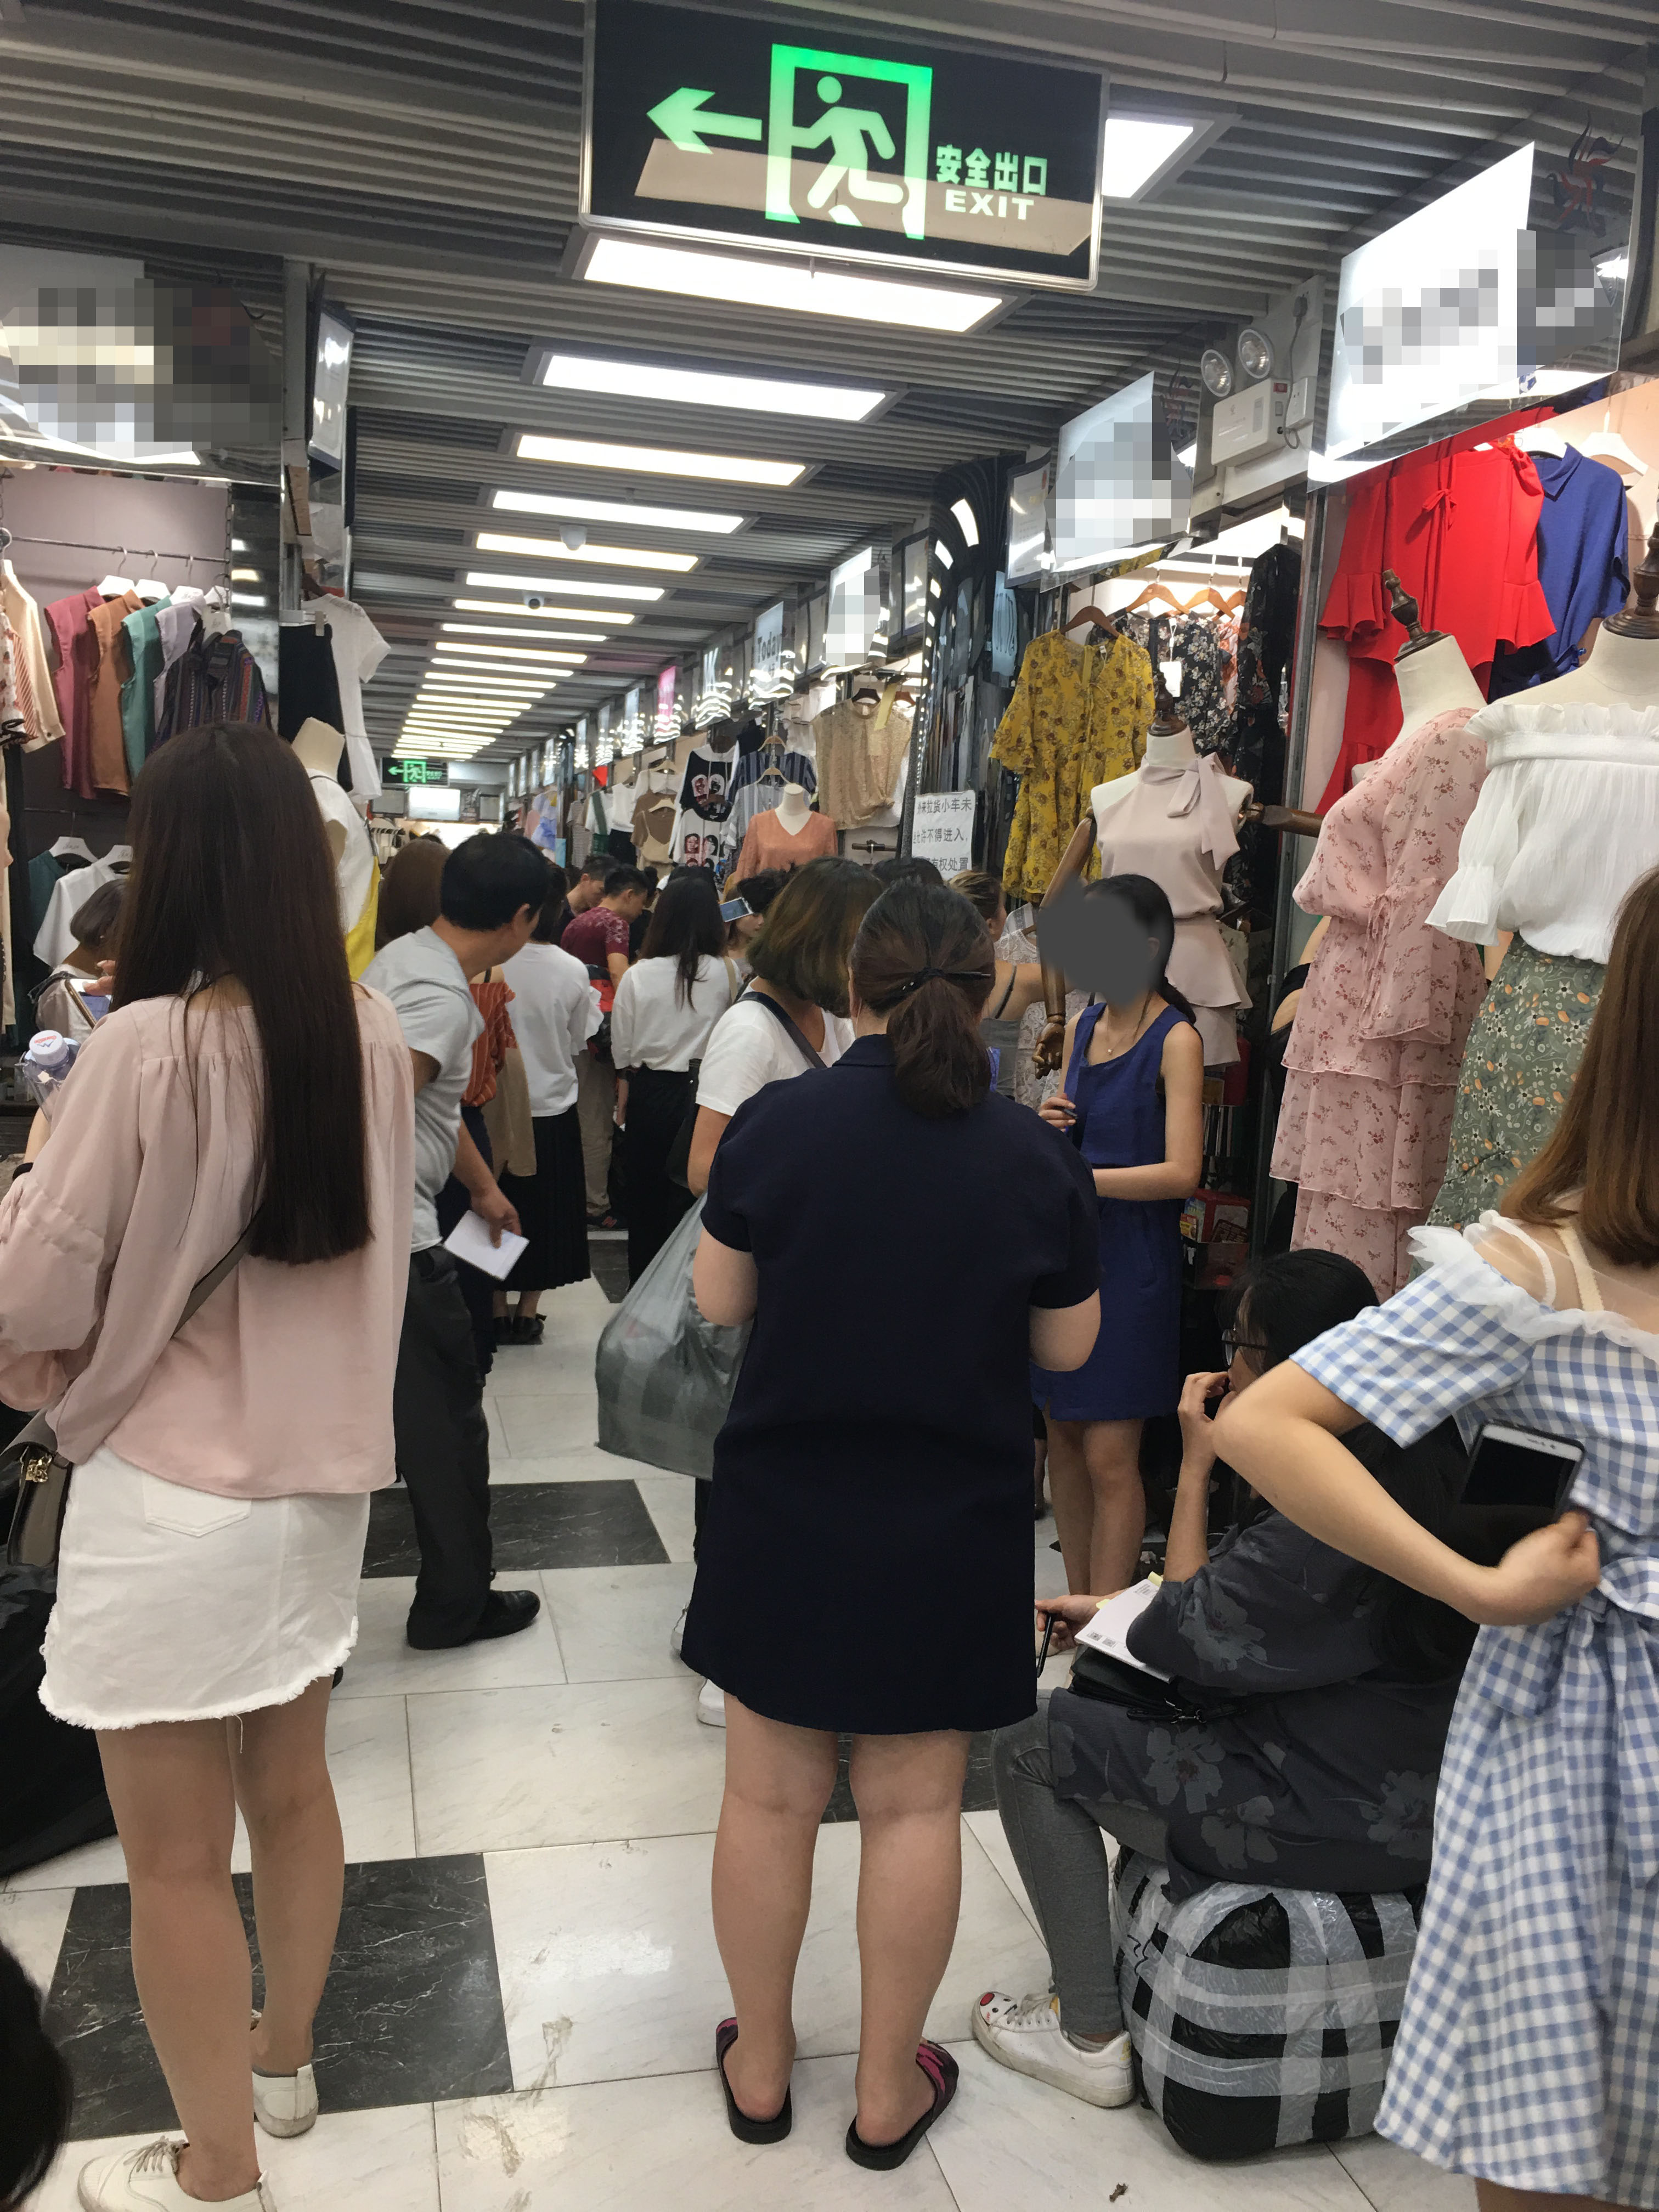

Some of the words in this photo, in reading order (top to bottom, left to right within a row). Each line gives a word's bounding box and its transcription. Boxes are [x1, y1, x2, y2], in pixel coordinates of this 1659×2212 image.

[936, 144, 1048, 195] 安全出口
[945, 190, 1034, 220] EXIT
